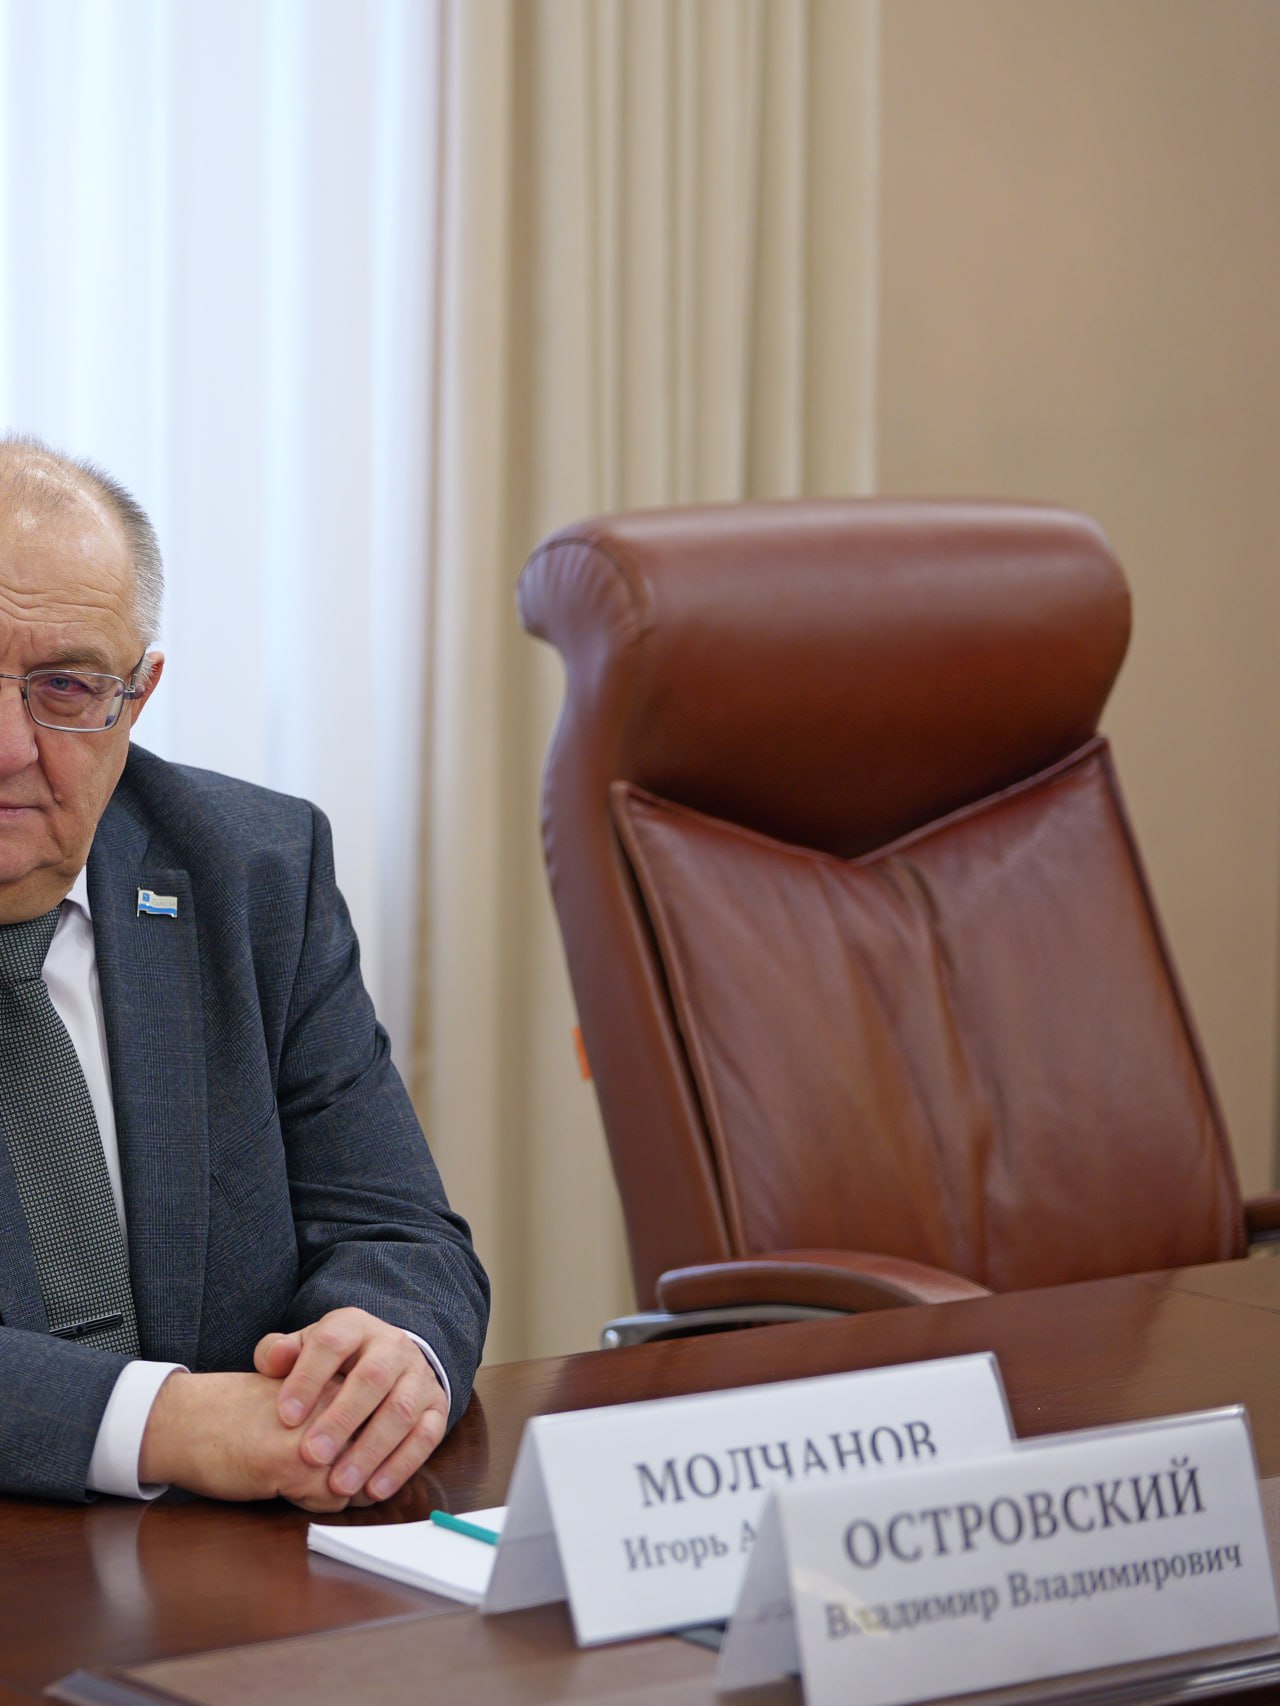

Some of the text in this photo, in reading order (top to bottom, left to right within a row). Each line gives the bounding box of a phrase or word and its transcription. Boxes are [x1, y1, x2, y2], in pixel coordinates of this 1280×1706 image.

[635, 1420, 936, 1508] МОЛЧАНОВ
[844, 1457, 1206, 1569] ОСТРОВСКИЙ
[623, 1532, 728, 1571] Игорь
[1008, 1543, 1243, 1608] Владимирович
